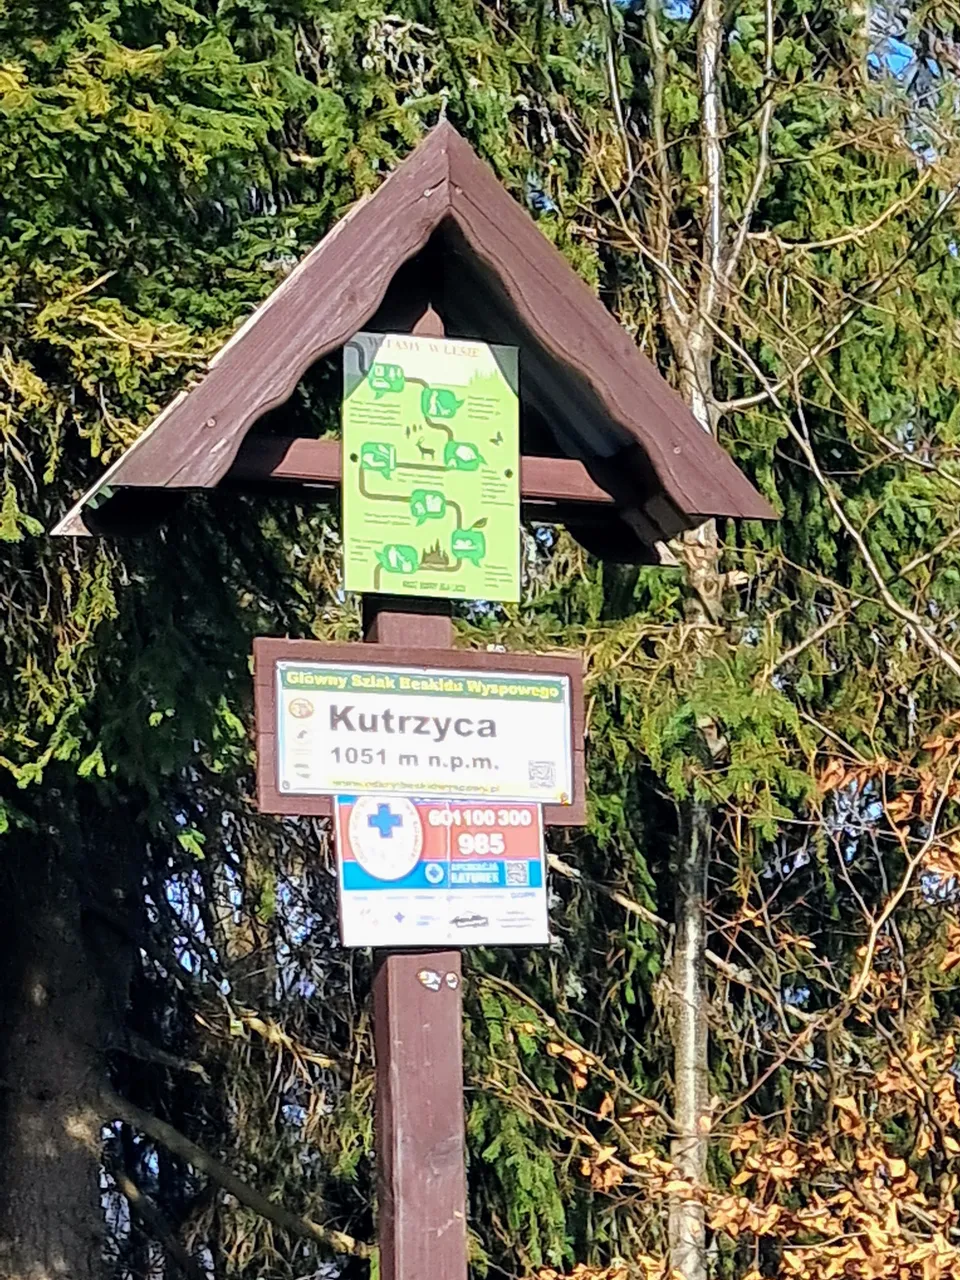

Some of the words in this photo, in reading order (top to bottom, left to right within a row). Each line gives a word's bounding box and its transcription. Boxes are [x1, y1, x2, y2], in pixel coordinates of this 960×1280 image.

[429, 344, 439, 353] W
[351, 674, 395, 689] Szlak
[399, 676, 464, 692] Beskidu
[466, 679, 560, 699] Wyspowego
[329, 704, 498, 743] Kutrzyca
[331, 747, 386, 765] 1051
[398, 753, 419, 767] m
[428, 755, 500, 772] n.p.m.
[428, 809, 461, 826] 601
[462, 809, 496, 826] 100
[497, 809, 532, 826] 300
[457, 832, 506, 855] 985
